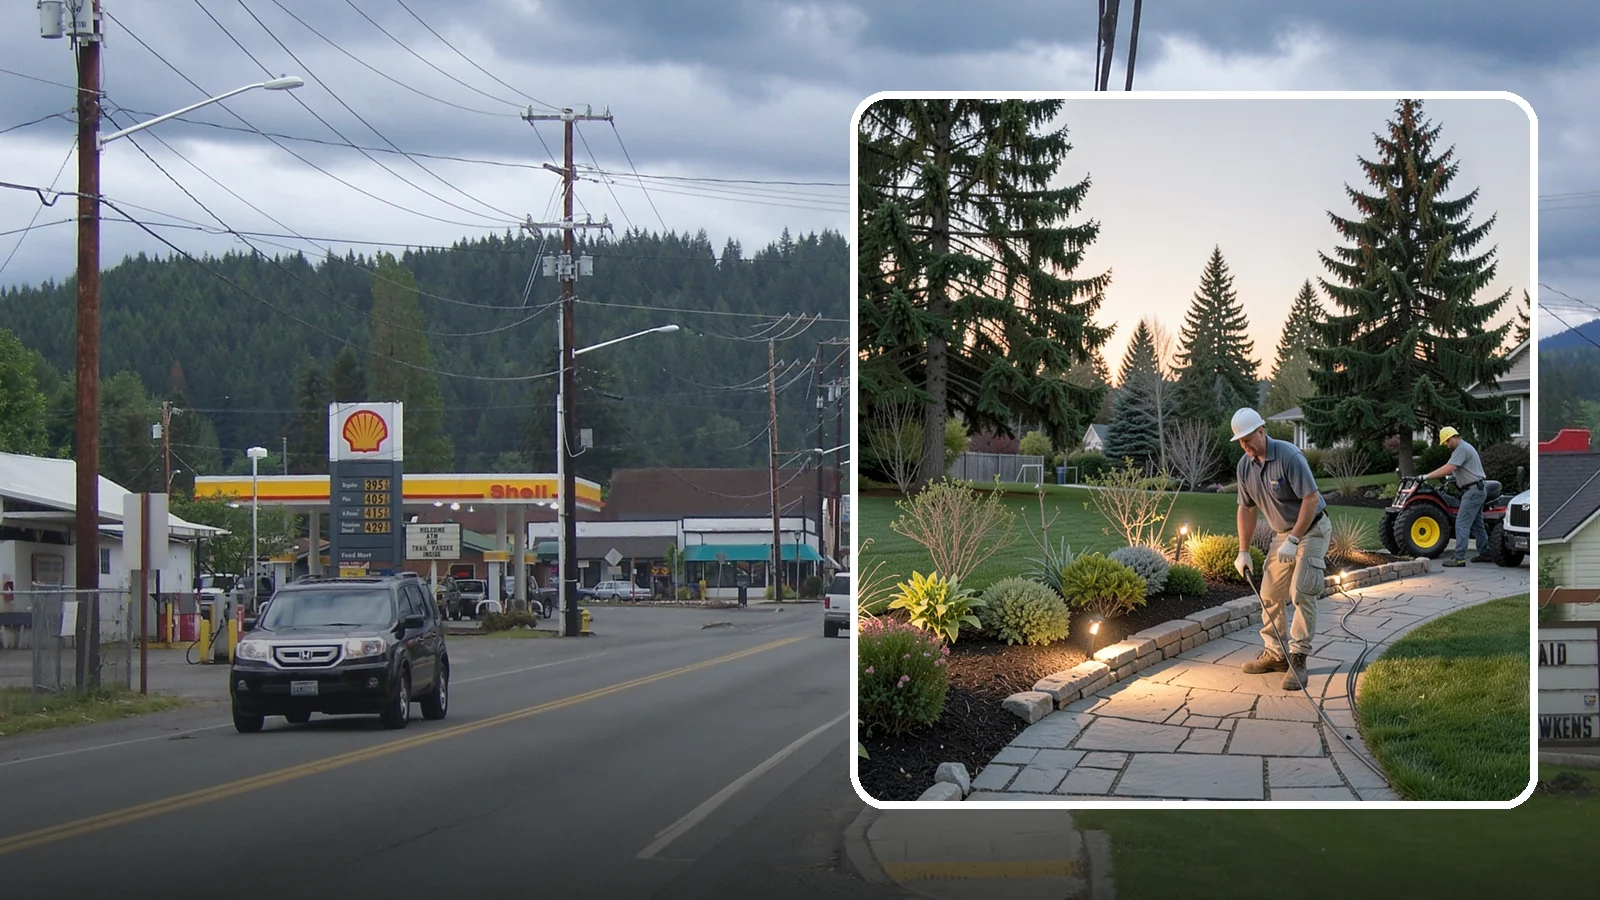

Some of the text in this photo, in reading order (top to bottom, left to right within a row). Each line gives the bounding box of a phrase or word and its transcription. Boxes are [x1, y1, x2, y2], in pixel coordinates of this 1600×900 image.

[366, 480, 383, 490] 395
[490, 484, 547, 499] Shell
[366, 494, 383, 504] 405
[366, 508, 383, 518] 415
[366, 522, 383, 532] 429
[1538, 642, 1567, 666] AID
